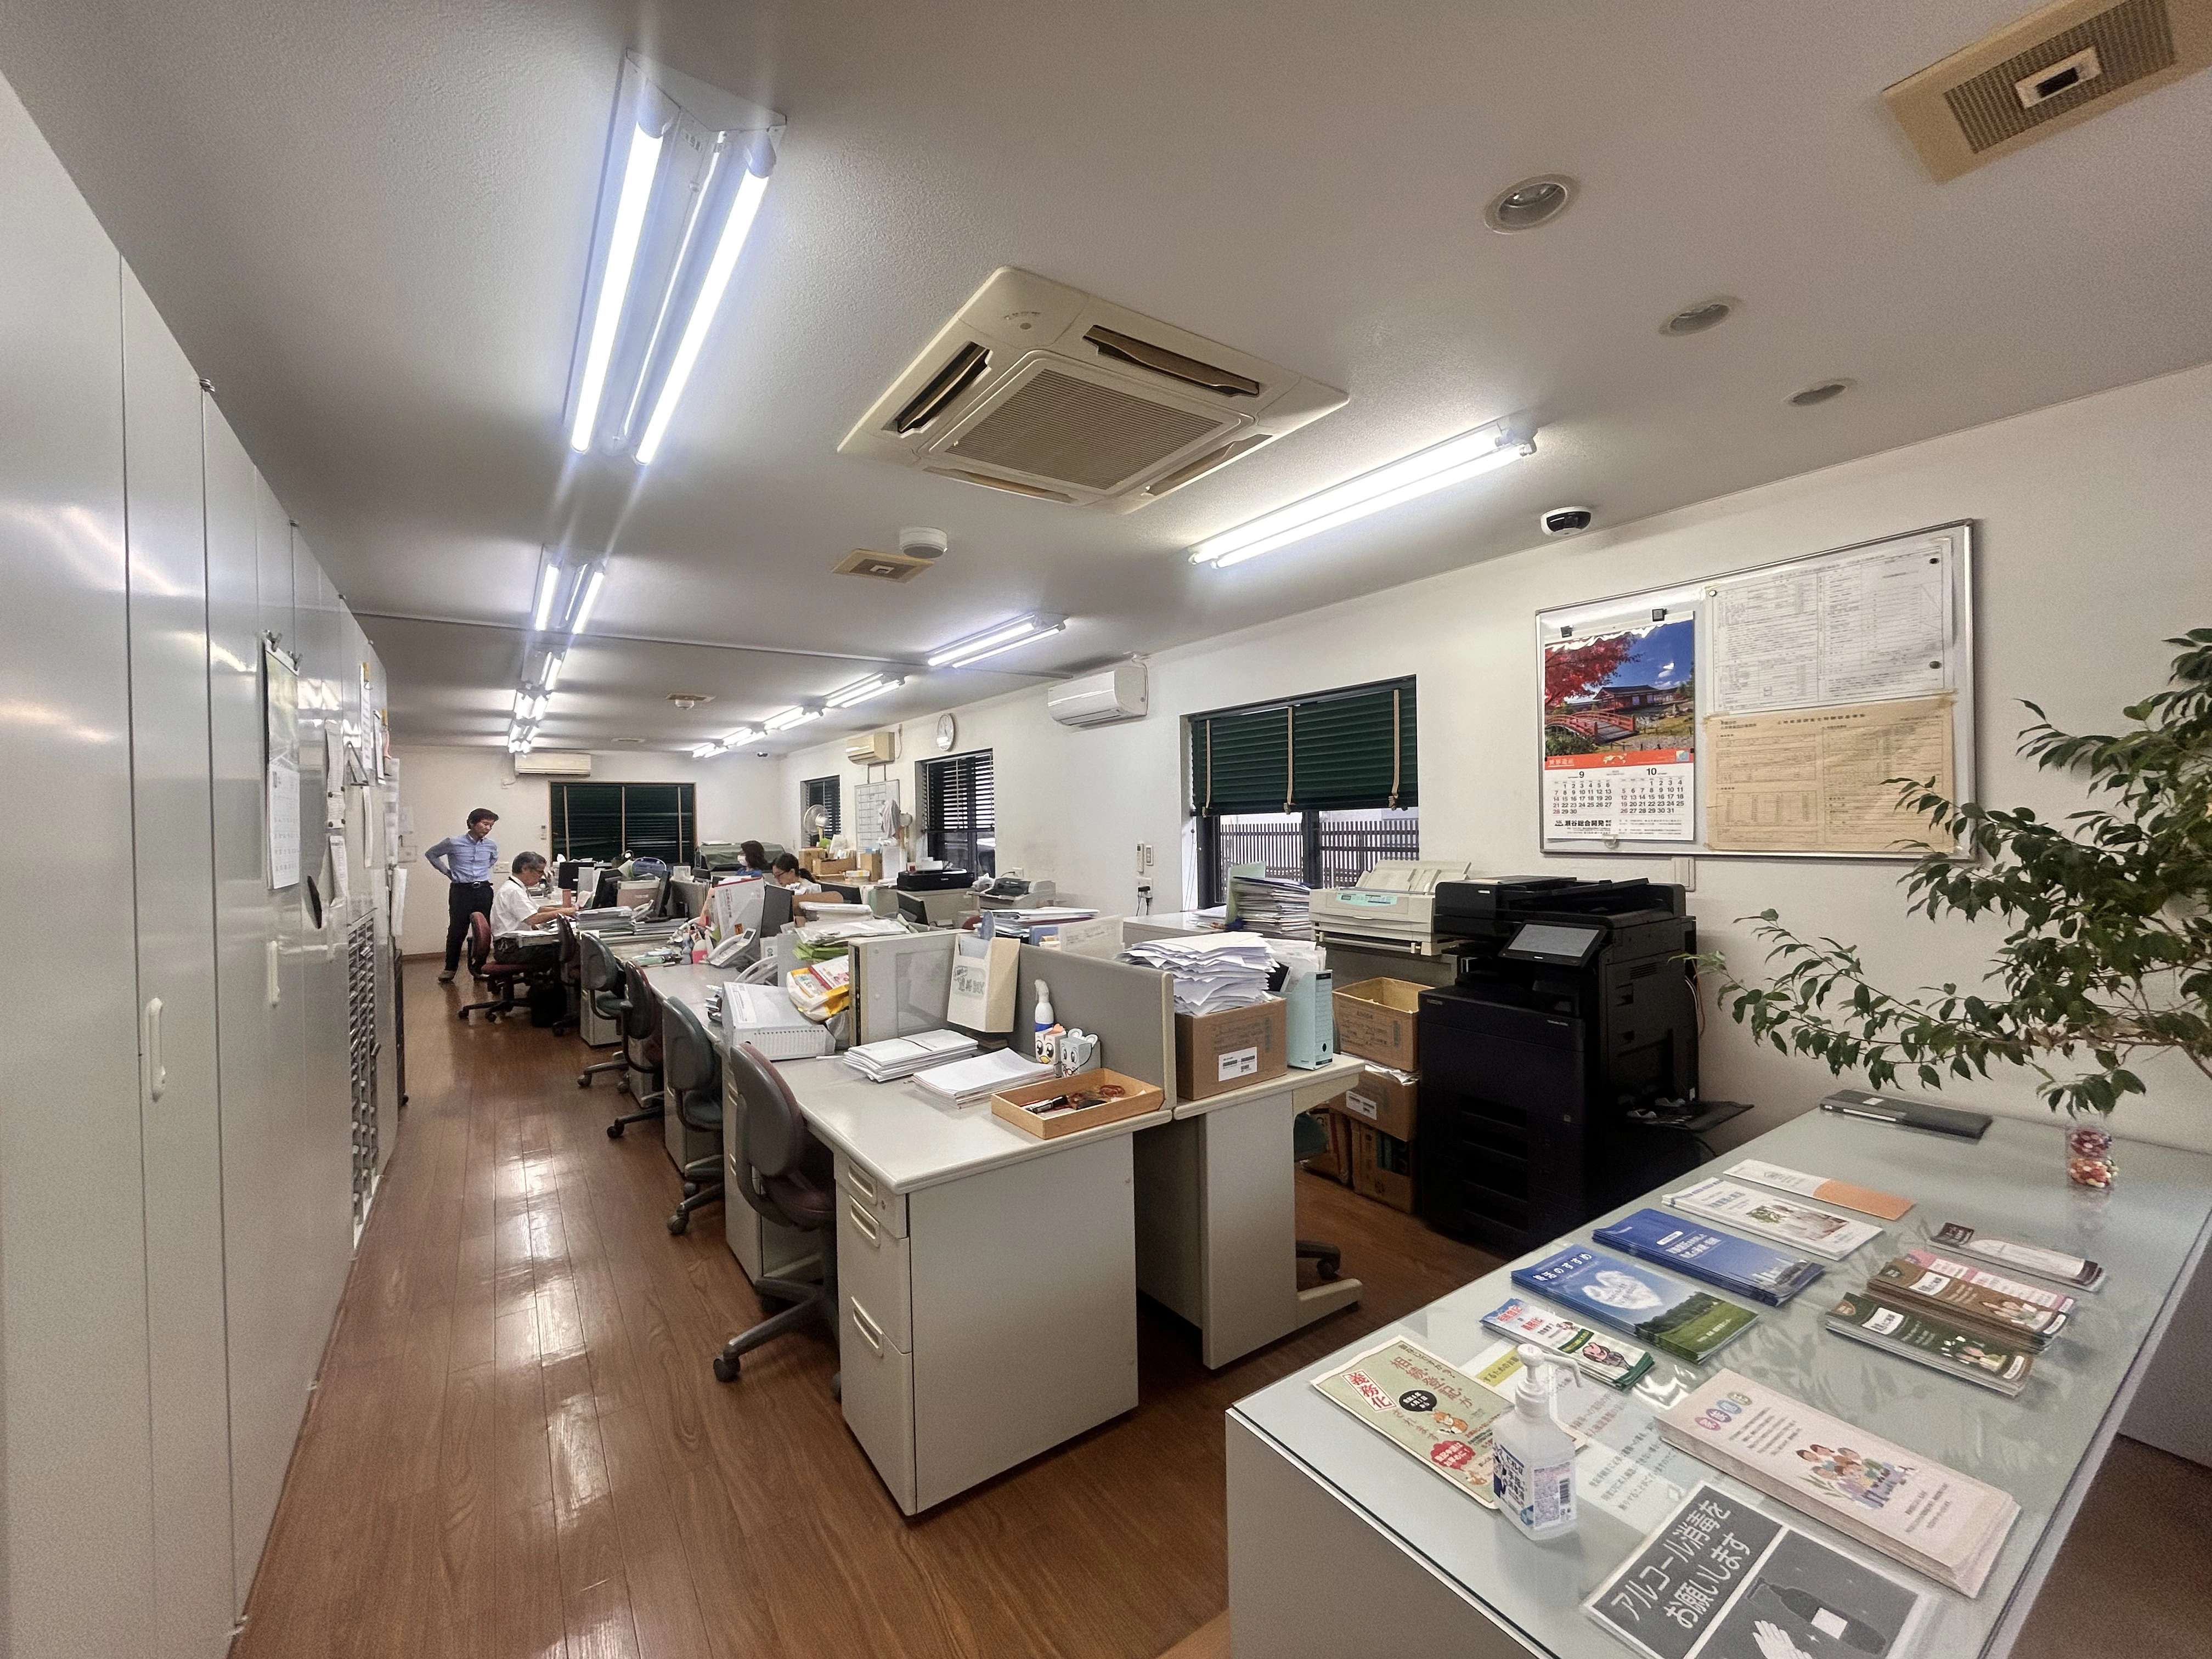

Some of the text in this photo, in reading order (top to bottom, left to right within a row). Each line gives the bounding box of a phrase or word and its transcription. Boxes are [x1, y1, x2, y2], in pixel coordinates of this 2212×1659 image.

[1348, 1372, 1392, 1409] 義務化
[1390, 1356, 1473, 1409] 相続登記が
[1393, 1408, 1439, 1441] されます
[1699, 1392, 1750, 1430] 家族信託
[1611, 1500, 1731, 1621] アルコール消毒を
[1663, 1532, 1750, 1629] お願いします
